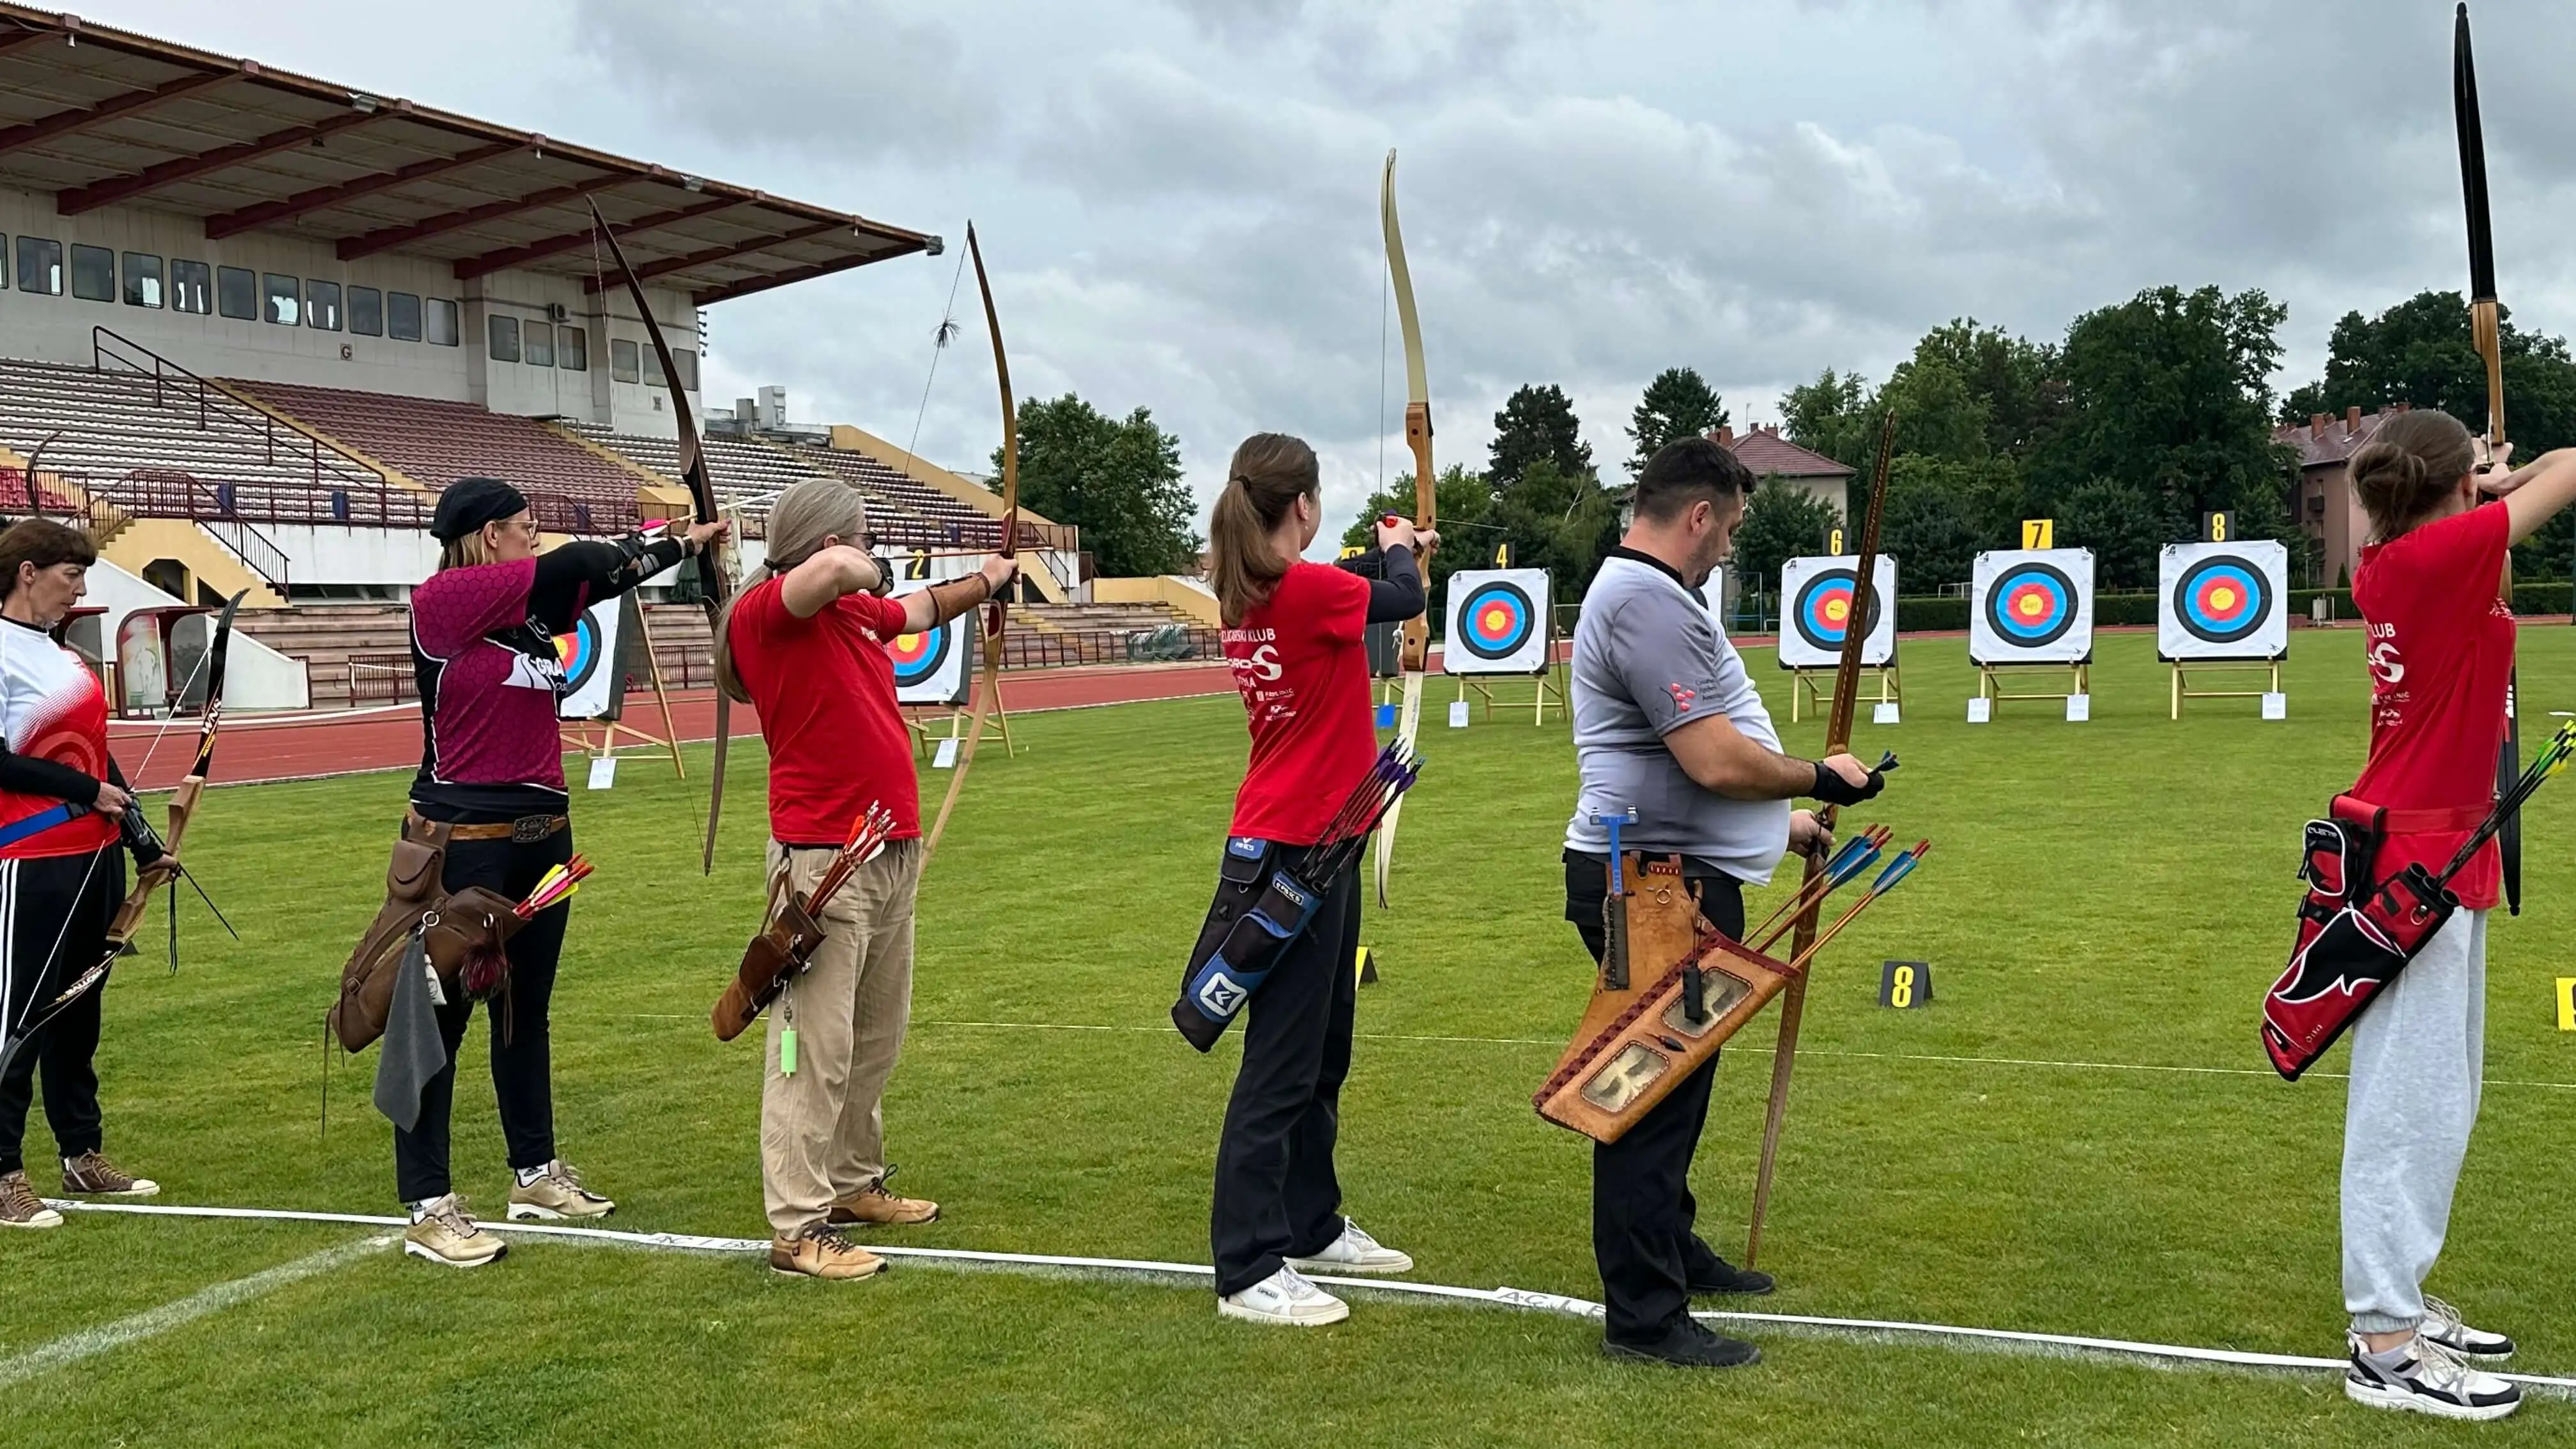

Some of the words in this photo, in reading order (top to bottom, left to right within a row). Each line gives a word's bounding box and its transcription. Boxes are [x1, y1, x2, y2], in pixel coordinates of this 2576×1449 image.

[342, 346, 351, 359] G
[2031, 523, 2044, 548] 7
[2212, 513, 2225, 541] 8
[1830, 529, 1843, 556] 6
[912, 549, 924, 579] 2
[1496, 544, 1508, 569] 4
[1248, 627, 1276, 642] KLUB
[1892, 966, 1914, 1008] 8
